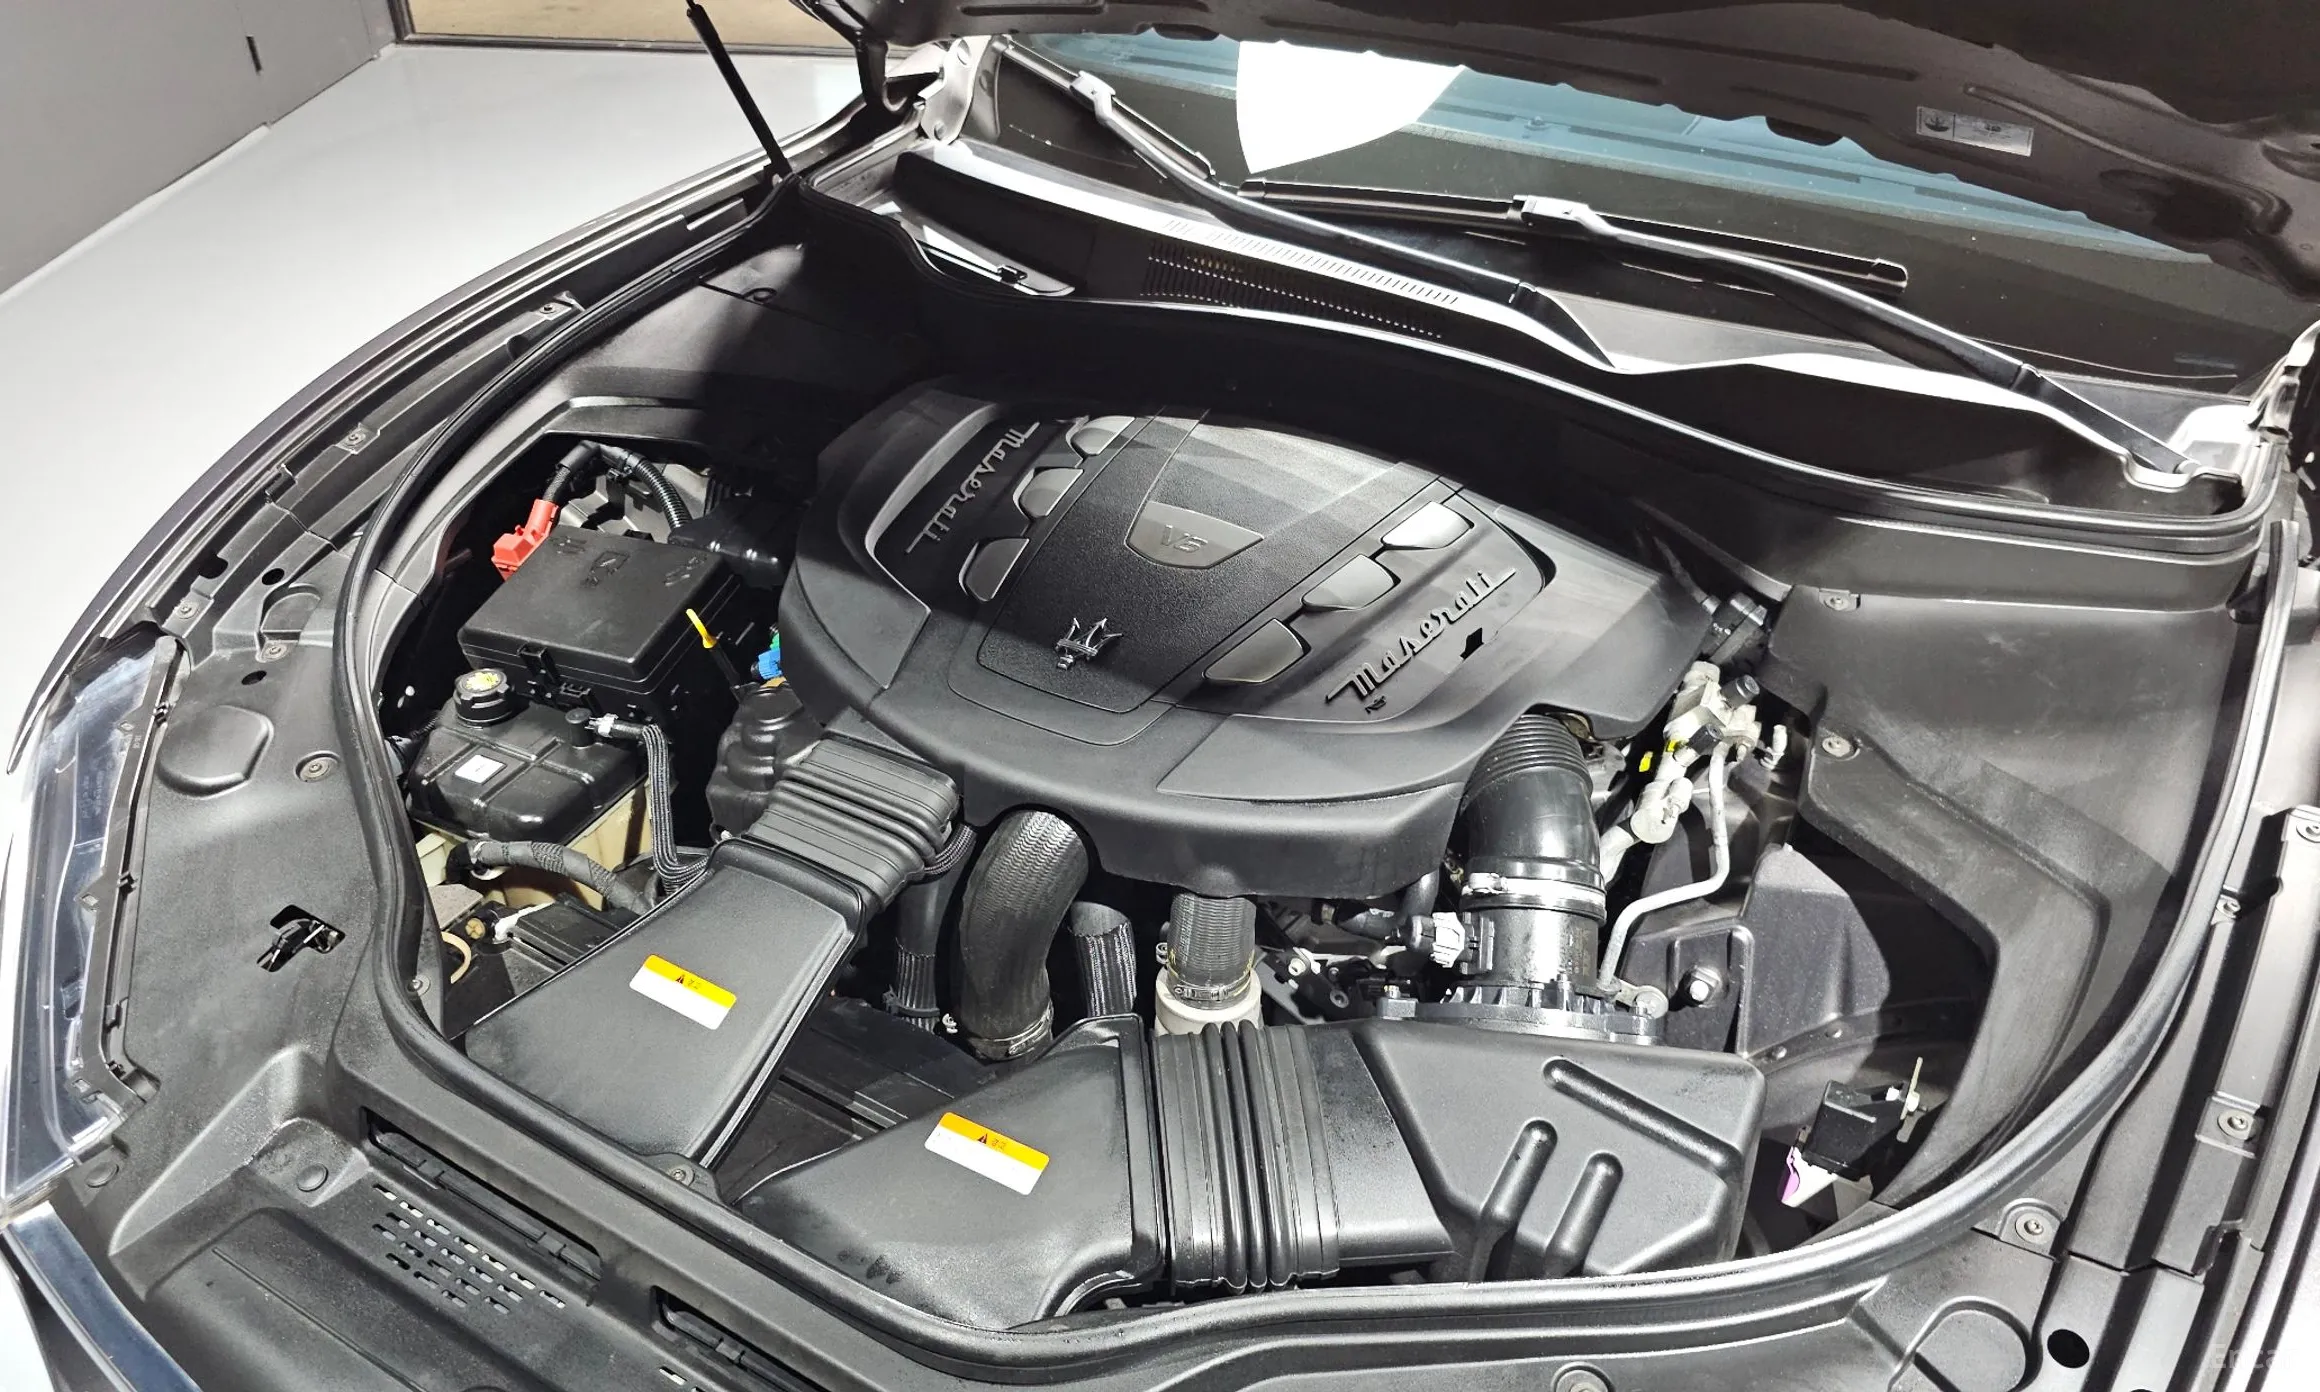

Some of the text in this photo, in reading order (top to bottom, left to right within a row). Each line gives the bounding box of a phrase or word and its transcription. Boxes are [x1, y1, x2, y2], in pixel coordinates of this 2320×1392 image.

[906, 421, 1040, 553] Maserati
[1161, 524, 1208, 553] V6
[1325, 567, 1516, 704] Maserati
